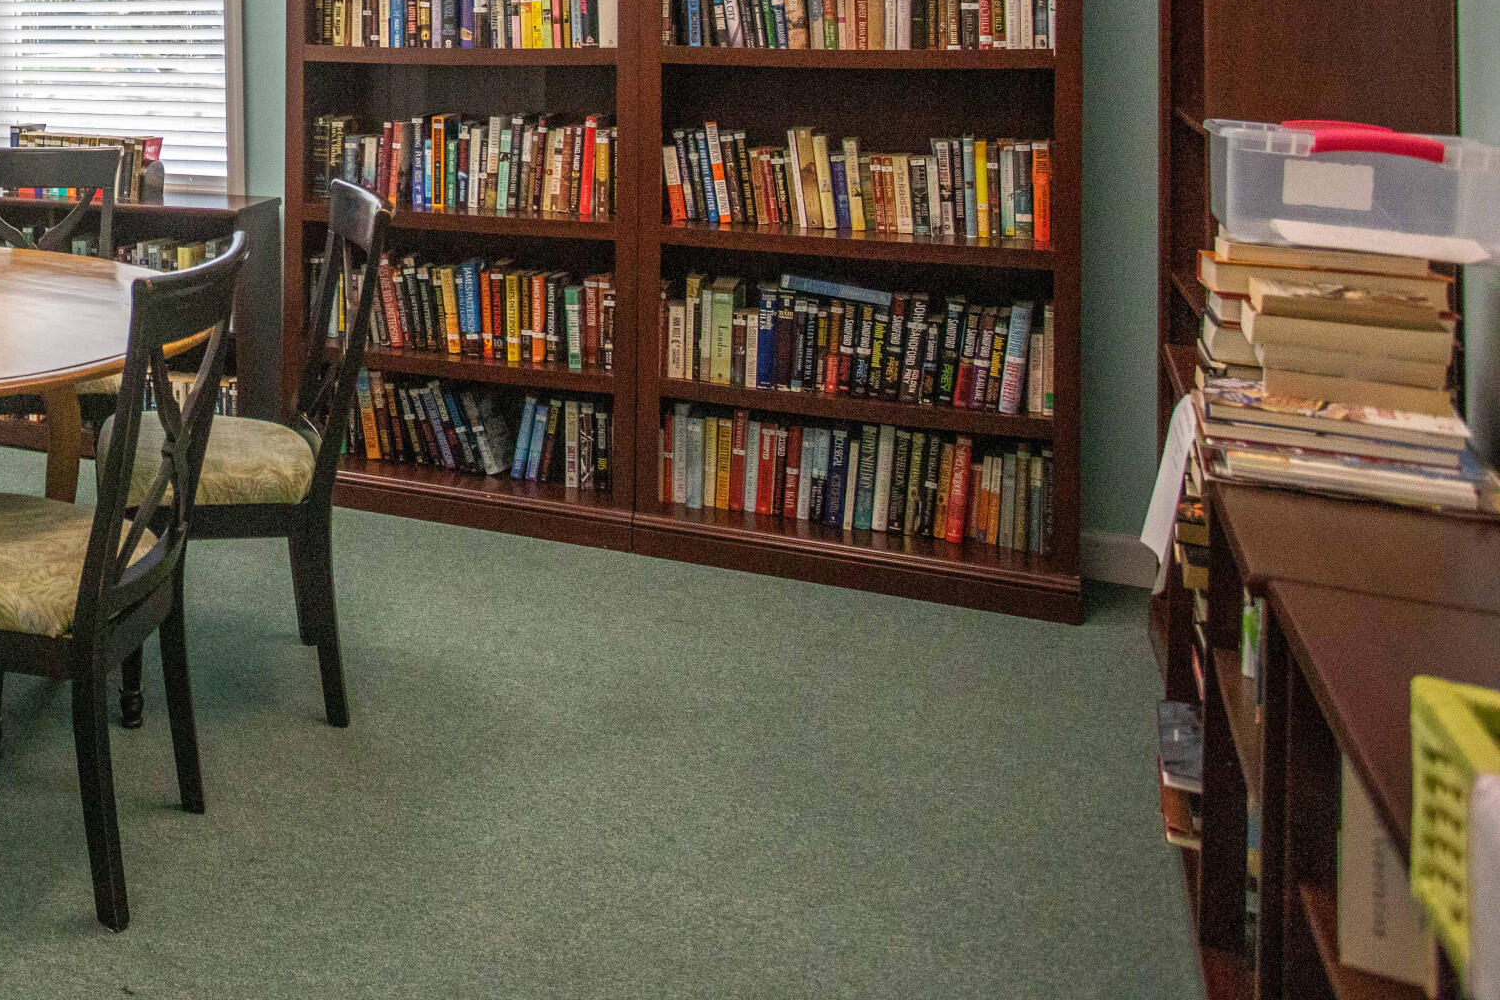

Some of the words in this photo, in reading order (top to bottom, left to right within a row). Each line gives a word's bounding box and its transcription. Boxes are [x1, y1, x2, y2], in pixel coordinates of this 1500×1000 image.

[725, 6, 736, 21] CITY
[980, 7, 990, 33] CHILD
[414, 150, 422, 168] POINT
[463, 267, 473, 291] JAMES
[547, 283, 555, 302] JAMES
[423, 302, 433, 336] PATTERSON
[465, 291, 475, 334] PATTERSON
[493, 295, 501, 336] PATTERSON
[508, 300, 516, 338] PATTERSON
[547, 302, 555, 336] PATTERSON
[716, 325, 728, 358] London
[843, 318, 853, 346] SANDFORD
[861, 321, 871, 348] SANDFORD
[874, 322, 886, 338] John
[890, 315, 904, 345] SANDFORD
[944, 318, 959, 348] SANDFORD
[963, 328, 977, 357] SANDFORD
[980, 329, 993, 358] SANDFORD
[994, 336, 1004, 350] John
[1008, 319, 1024, 357] SANDFORD
[871, 339, 884, 368] Sandford
[905, 327, 922, 366] SANDFORD
[856, 359, 864, 384] PREY
[885, 356, 896, 383] PREY
[903, 368, 912, 384] PREY
[940, 363, 950, 391] PREY
[989, 351, 1003, 377] Sandford
[908, 369, 919, 393] GOLDEN
[974, 369, 986, 401] DEADLINE
[1002, 378, 1017, 402] FREEZE
[833, 449, 843, 466] SEGAL
